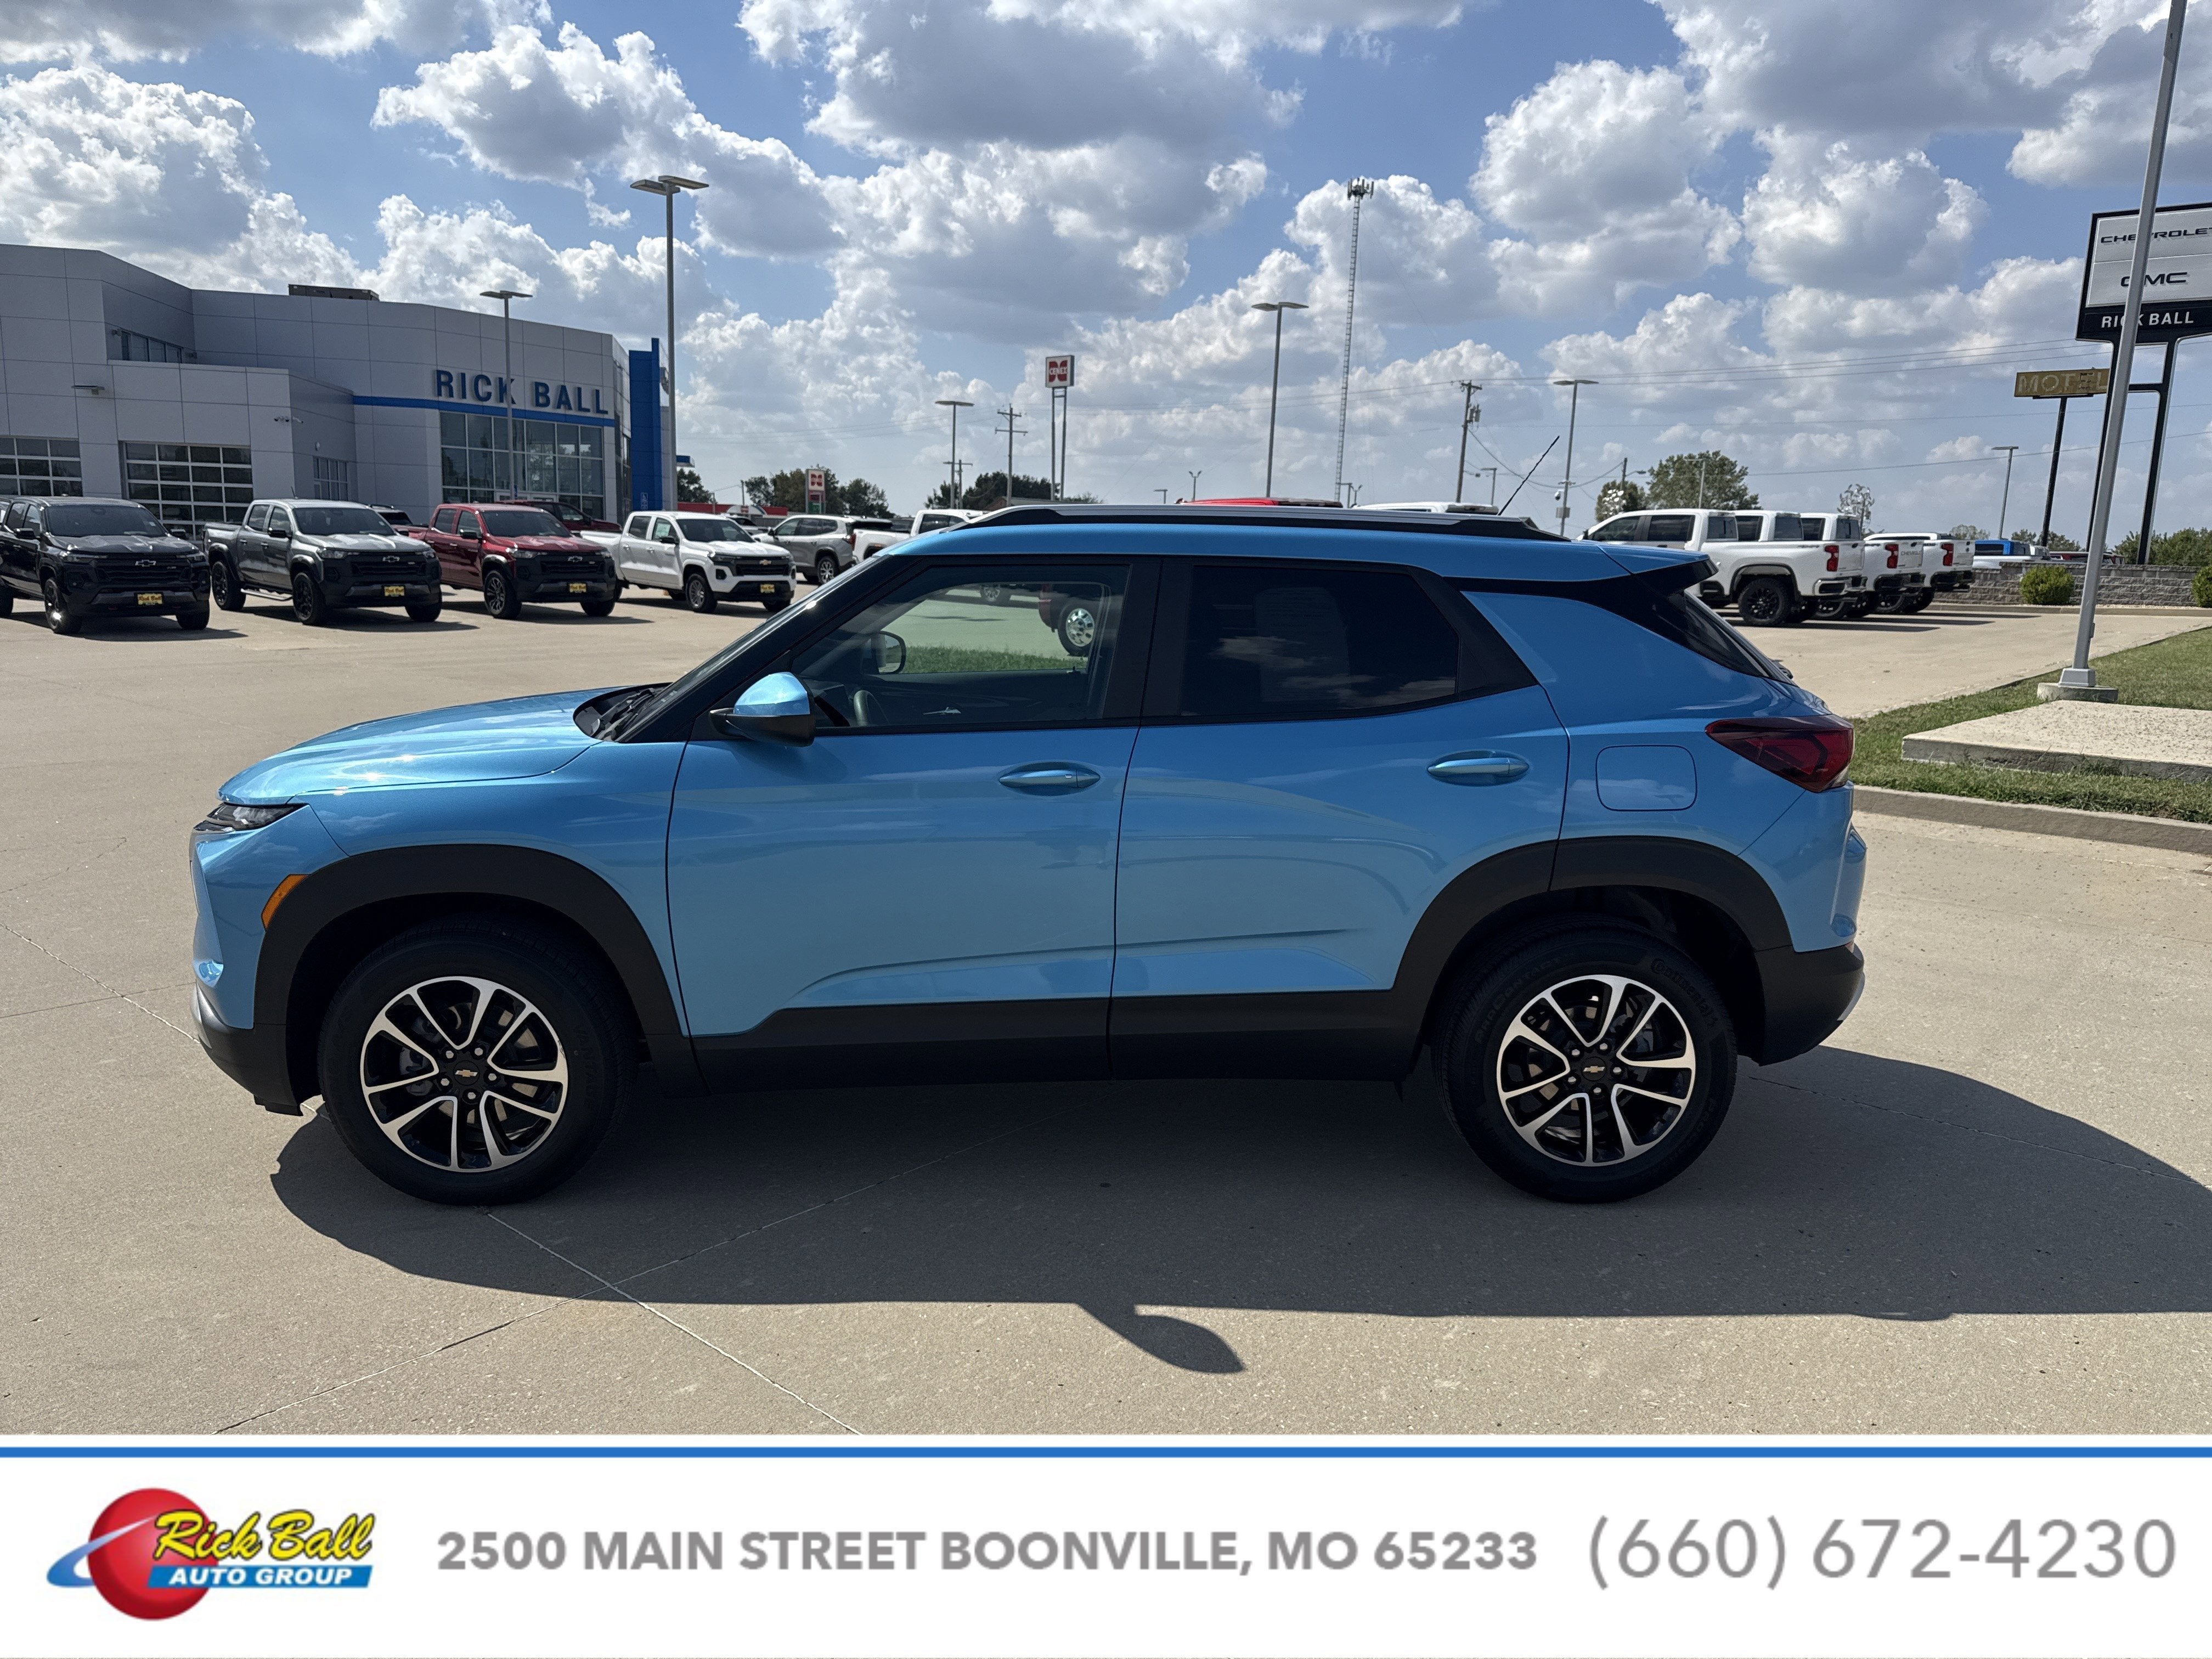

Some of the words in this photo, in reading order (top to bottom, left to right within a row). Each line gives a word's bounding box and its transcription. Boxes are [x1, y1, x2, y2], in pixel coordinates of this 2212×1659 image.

[2101, 227, 2212, 243] CHEROLE
[2149, 311, 2194, 326] BALL
[2018, 371, 2107, 393] MOTEL
[436, 369, 516, 405] RICK
[534, 381, 609, 415] BALL
